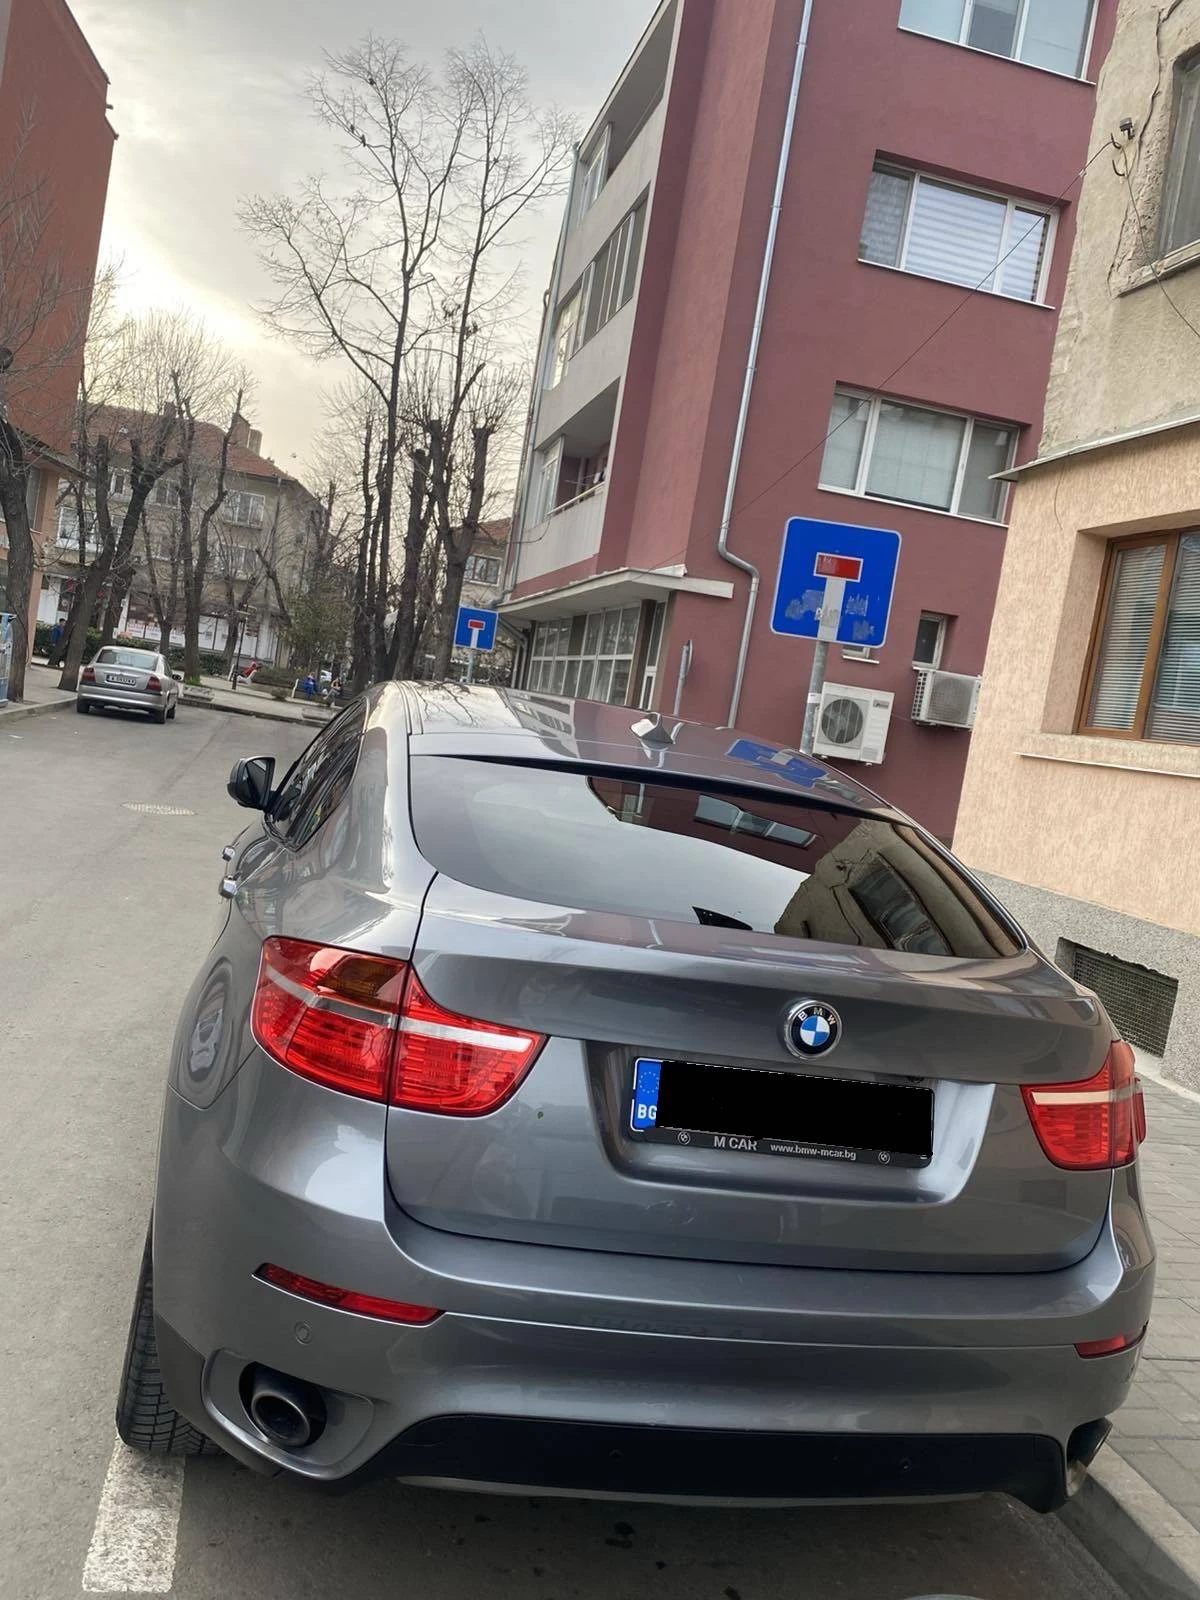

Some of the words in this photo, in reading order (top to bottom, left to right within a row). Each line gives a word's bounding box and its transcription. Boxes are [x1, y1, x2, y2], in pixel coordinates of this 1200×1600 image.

[798, 1007, 836, 1025] BMW
[637, 1103, 658, 1120] BG
[713, 1135, 726, 1148] M
[728, 1137, 758, 1151] CAR
[770, 1143, 857, 1161] www.bmw-mcar.bg
